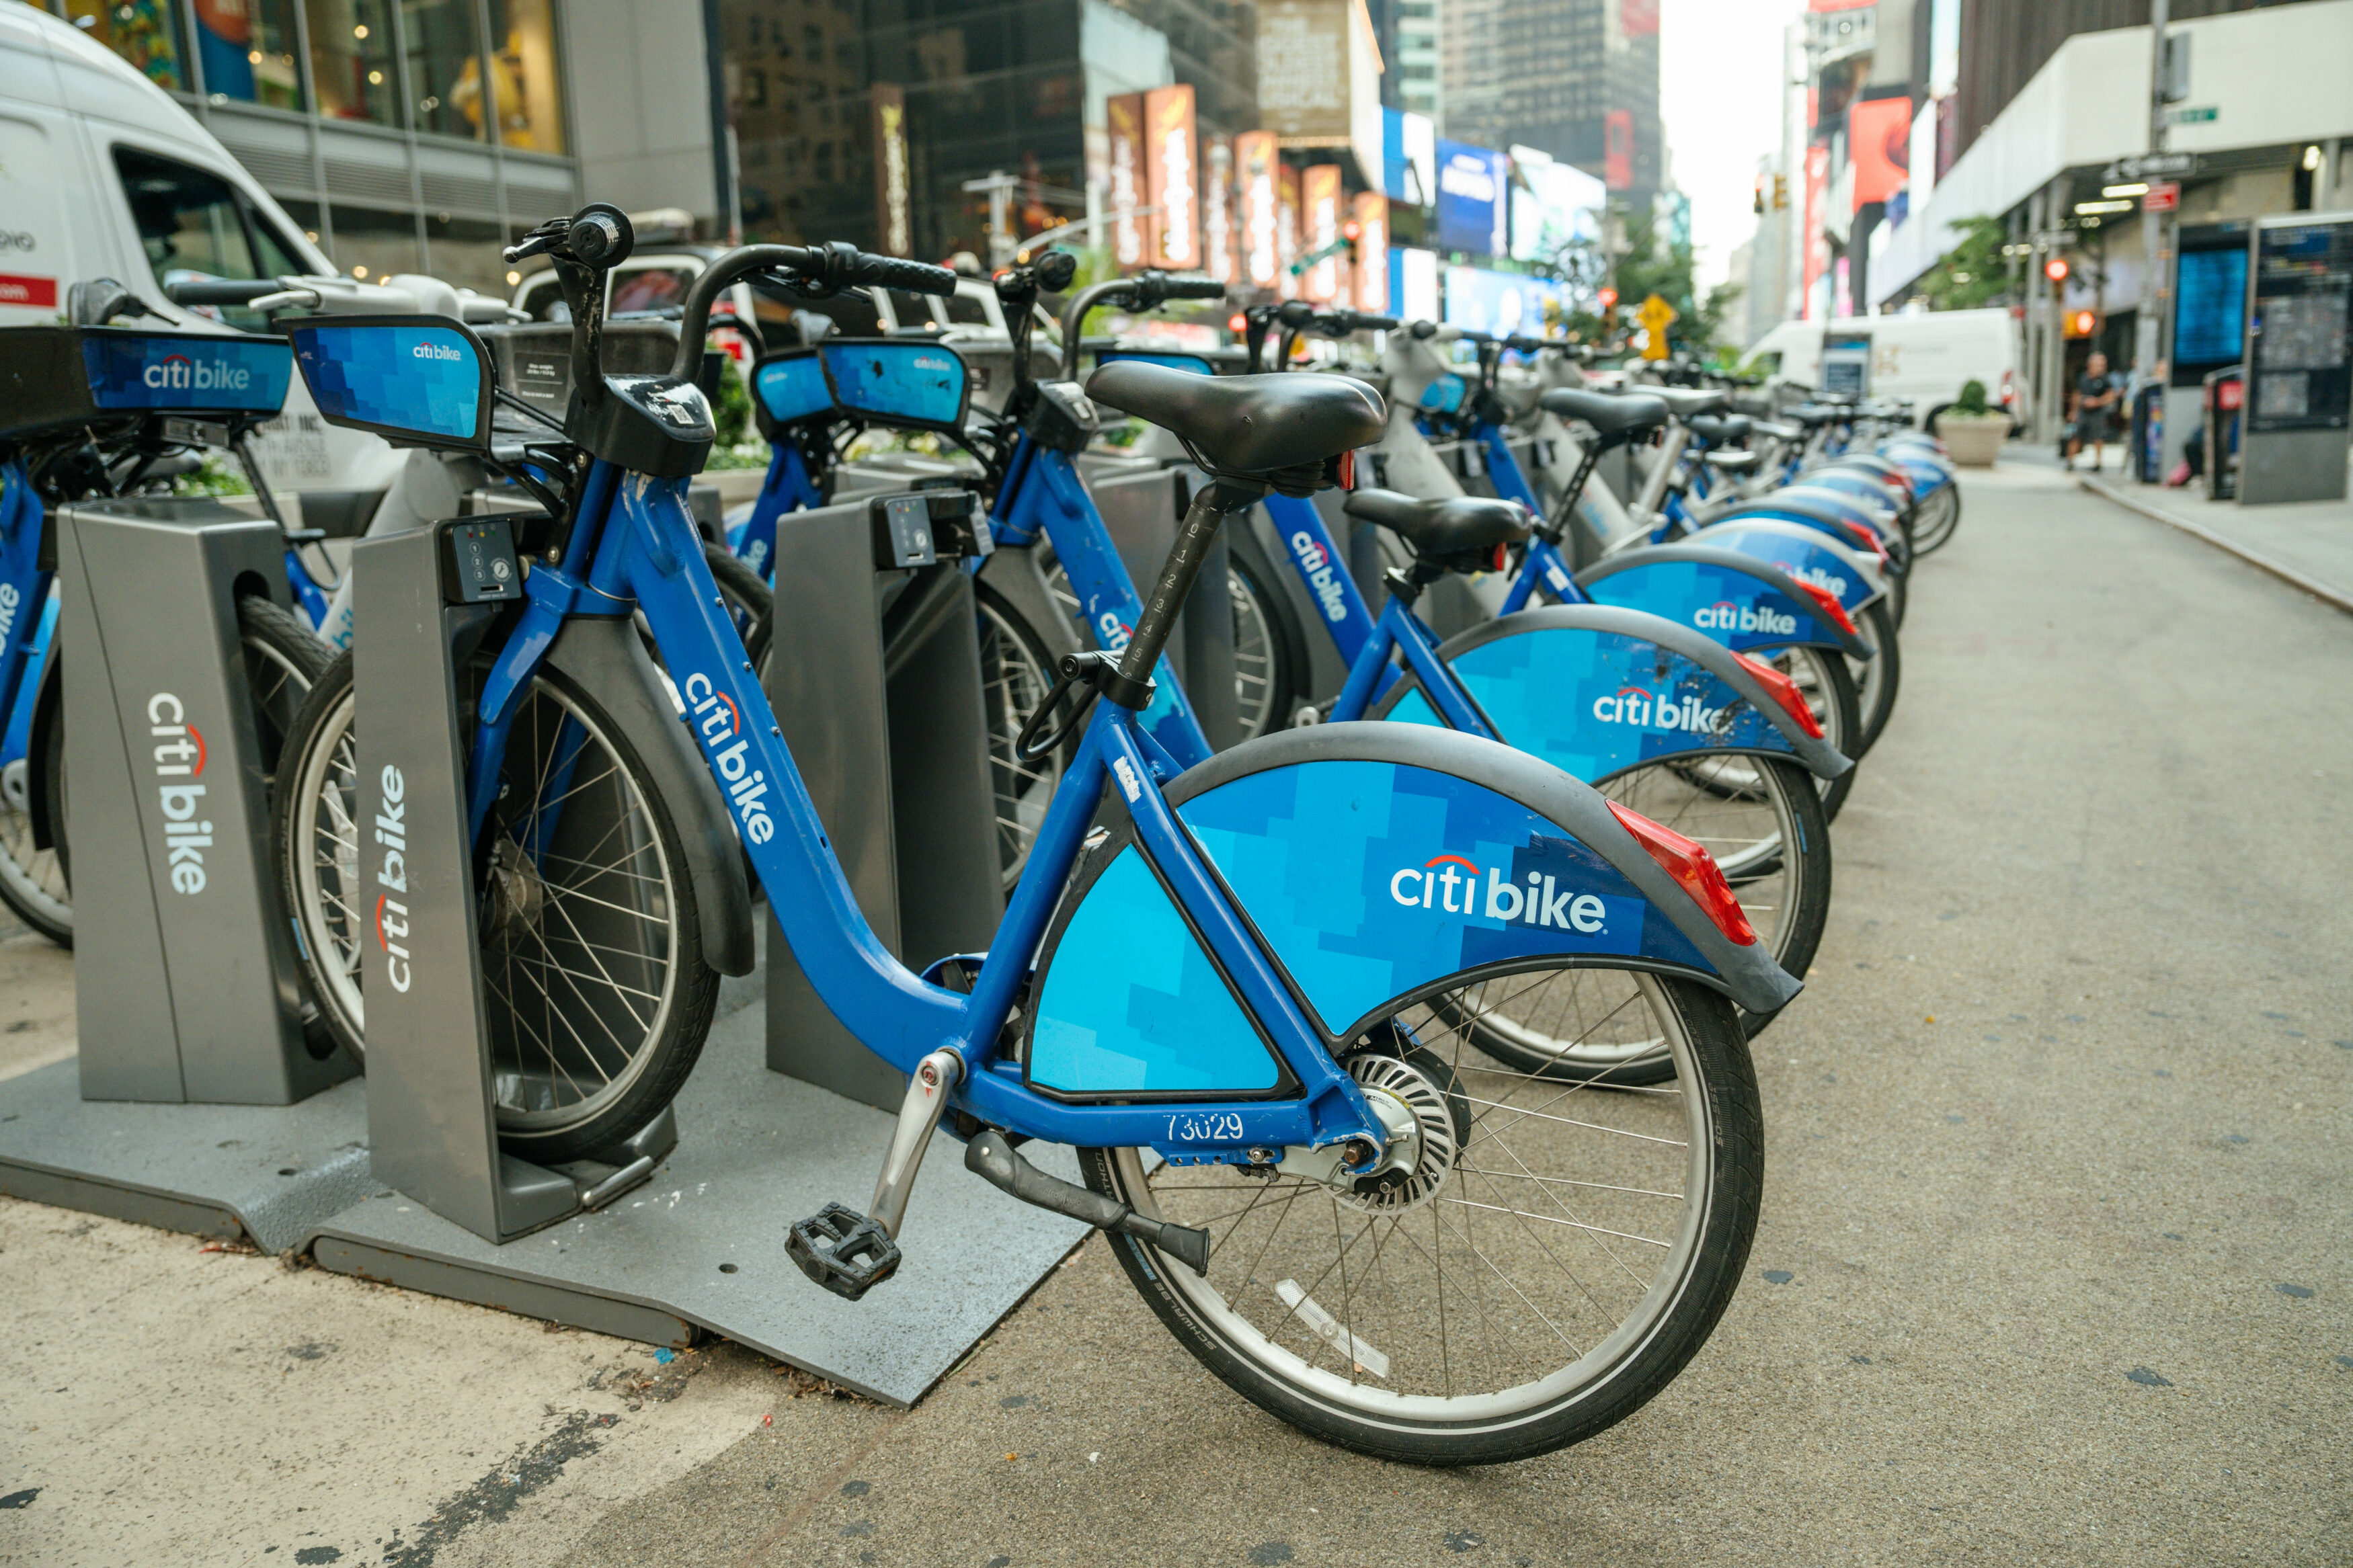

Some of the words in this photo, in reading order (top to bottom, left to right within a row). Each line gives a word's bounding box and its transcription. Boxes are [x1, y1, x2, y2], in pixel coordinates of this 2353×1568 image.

[413, 341, 434, 359] citi
[434, 345, 461, 362] bike
[143, 354, 192, 388] citi
[194, 359, 250, 390] bike
[1190, 523, 1199, 534] 0
[475, 558, 481, 566] 2
[1181, 549, 1187, 559] 1
[1167, 574, 1176, 585] 2
[1310, 566, 1347, 622] bike
[1156, 599, 1164, 609] 3
[1693, 601, 1738, 630] citi
[1739, 606, 1797, 634] bike
[1099, 612, 1134, 651] cit
[1145, 624, 1153, 634] 4
[1134, 648, 1143, 658] 5
[1593, 687, 1653, 727] citi
[148, 692, 206, 777] citi
[684, 672, 740, 748] citi
[716, 739, 774, 845] bike
[159, 784, 213, 895] bike
[374, 764, 408, 893] bike
[1390, 855, 1481, 915] citi
[1485, 867, 1605, 933] bike
[376, 893, 411, 993] citi
[1162, 1113, 1243, 1141] 73029
[1154, 1282, 1217, 1350] SCHWALBE
